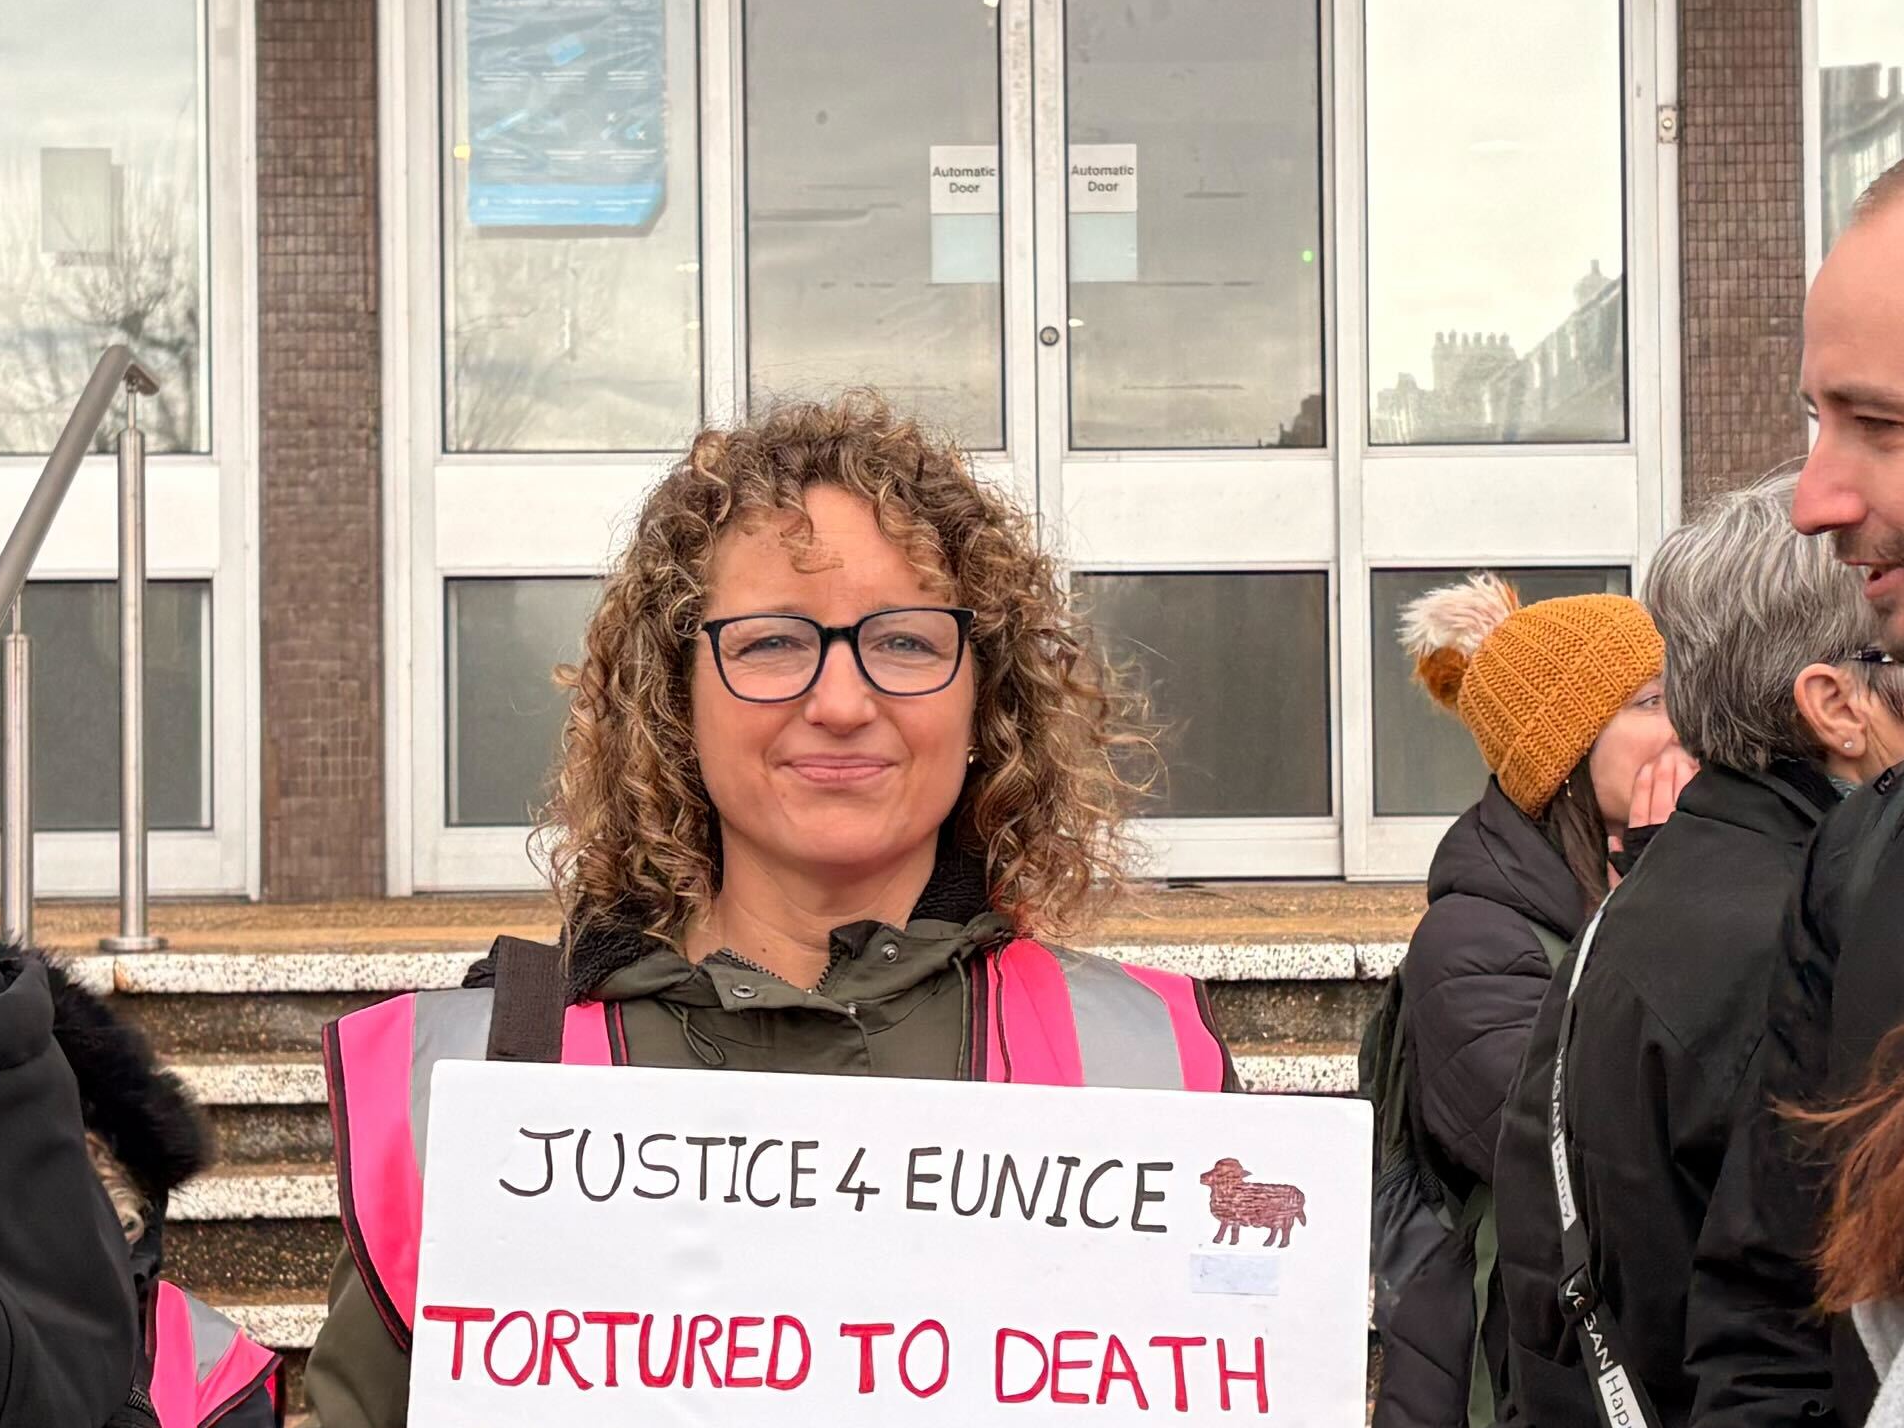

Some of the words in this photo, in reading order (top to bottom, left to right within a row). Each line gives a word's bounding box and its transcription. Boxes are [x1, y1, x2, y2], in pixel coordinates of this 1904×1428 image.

[932, 165, 997, 177] Automatic
[1071, 164, 1135, 176] Automatic
[949, 182, 981, 193] Door
[1088, 180, 1120, 192] Door
[499, 1126, 820, 1208] JUSTICE
[835, 1146, 880, 1212] 4
[905, 1146, 1174, 1234] EUNICE
[422, 1304, 812, 1391] TORTURED
[839, 1318, 951, 1399] TO
[995, 1328, 1271, 1413] DEATH
